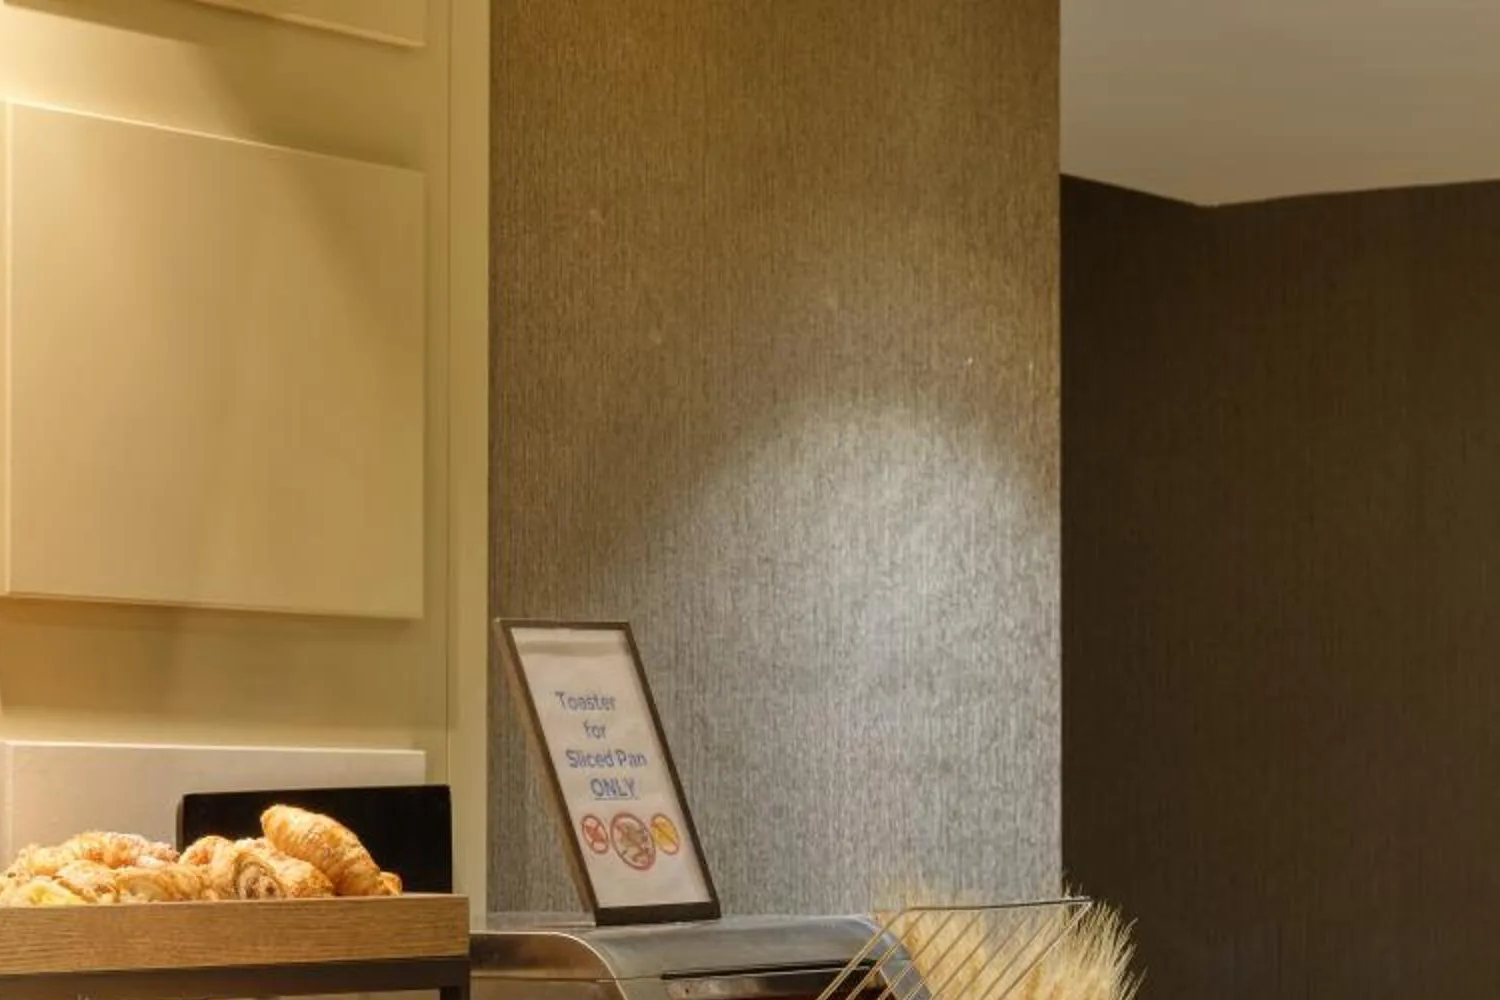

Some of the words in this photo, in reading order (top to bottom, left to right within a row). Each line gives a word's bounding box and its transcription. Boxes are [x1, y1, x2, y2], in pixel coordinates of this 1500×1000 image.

[555, 691, 616, 712] Toaster
[583, 719, 607, 740] for
[566, 749, 614, 769] Sliced
[616, 750, 647, 768] Pan
[590, 777, 638, 799] ONLY
